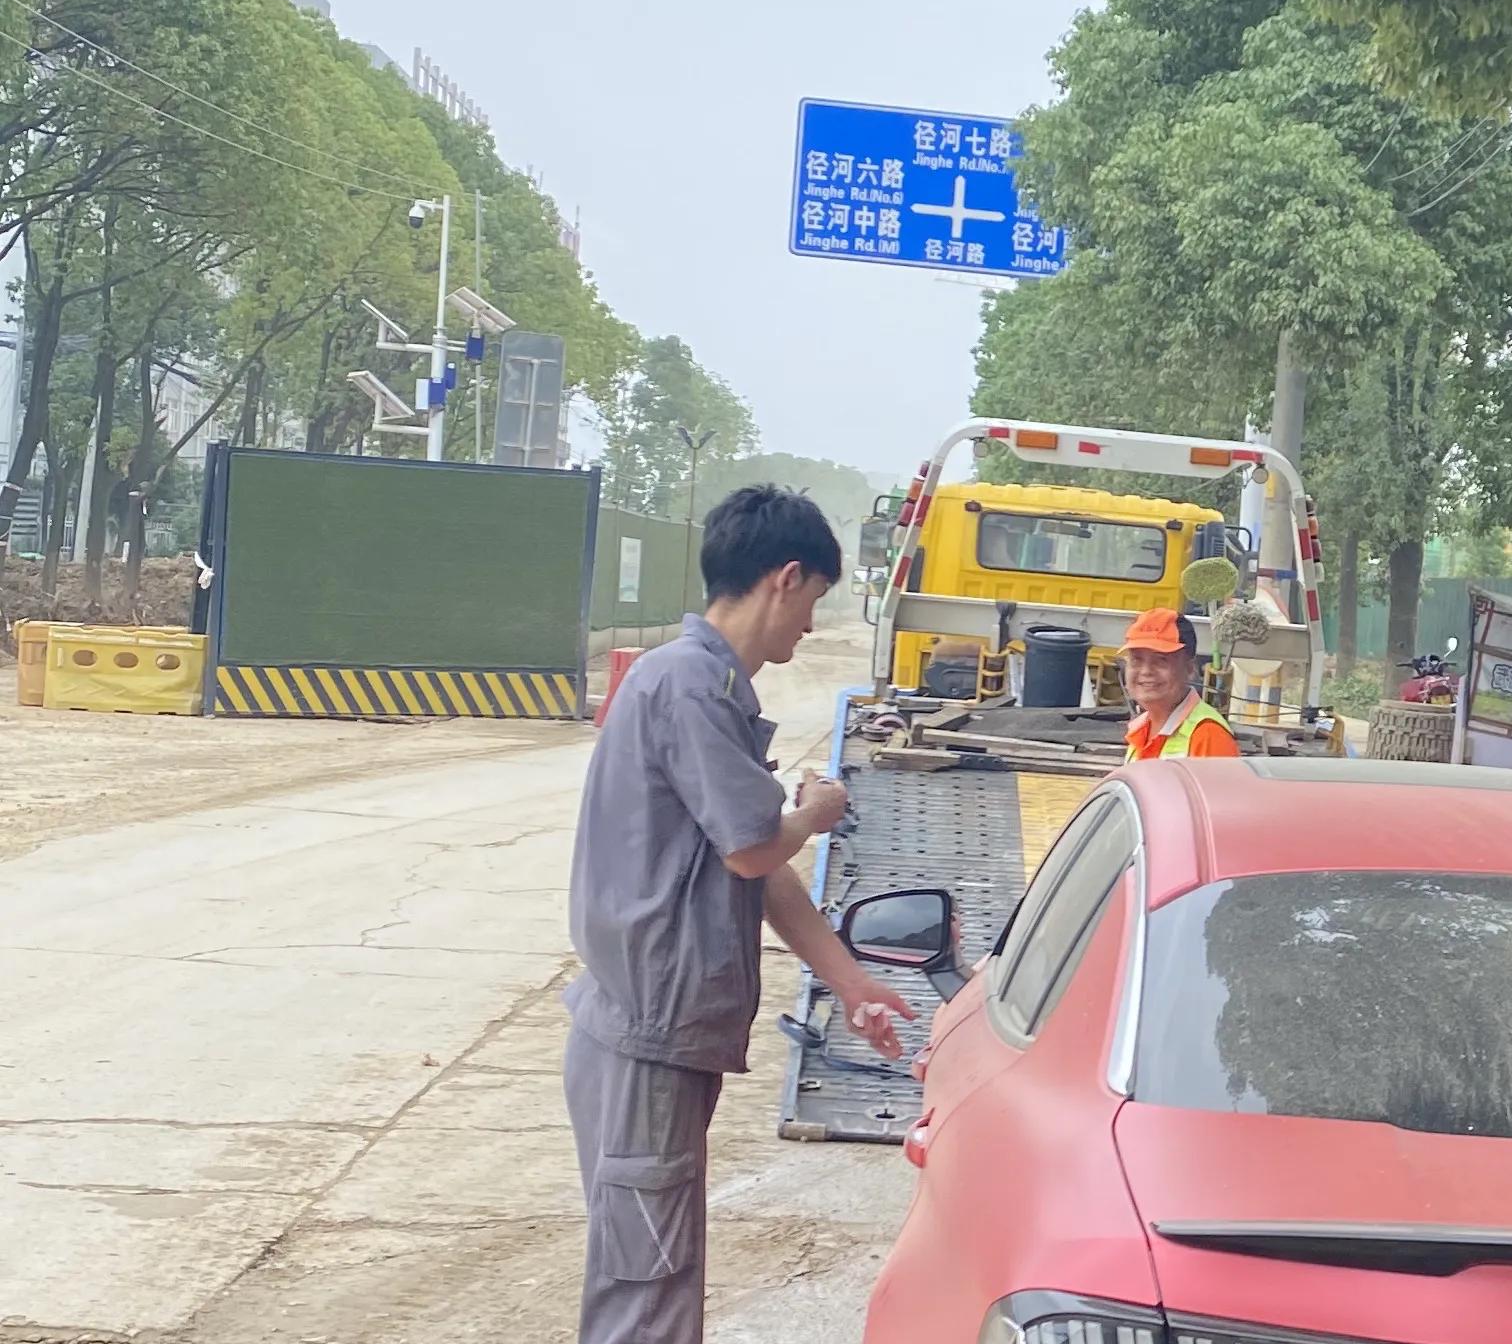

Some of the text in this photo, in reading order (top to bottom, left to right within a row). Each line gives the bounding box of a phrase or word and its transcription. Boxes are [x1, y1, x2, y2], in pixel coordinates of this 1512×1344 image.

[914, 120, 1012, 158] 径河七路
[806, 149, 905, 189] 径河六路
[912, 151, 954, 170] Jinghe
[803, 181, 845, 200] Jinghe
[802, 199, 902, 239] 径河中路
[799, 231, 849, 250] Jinghe
[924, 238, 985, 265] 径河路
[1011, 221, 1072, 256] 径河
[1010, 253, 1060, 272] Jinghe
